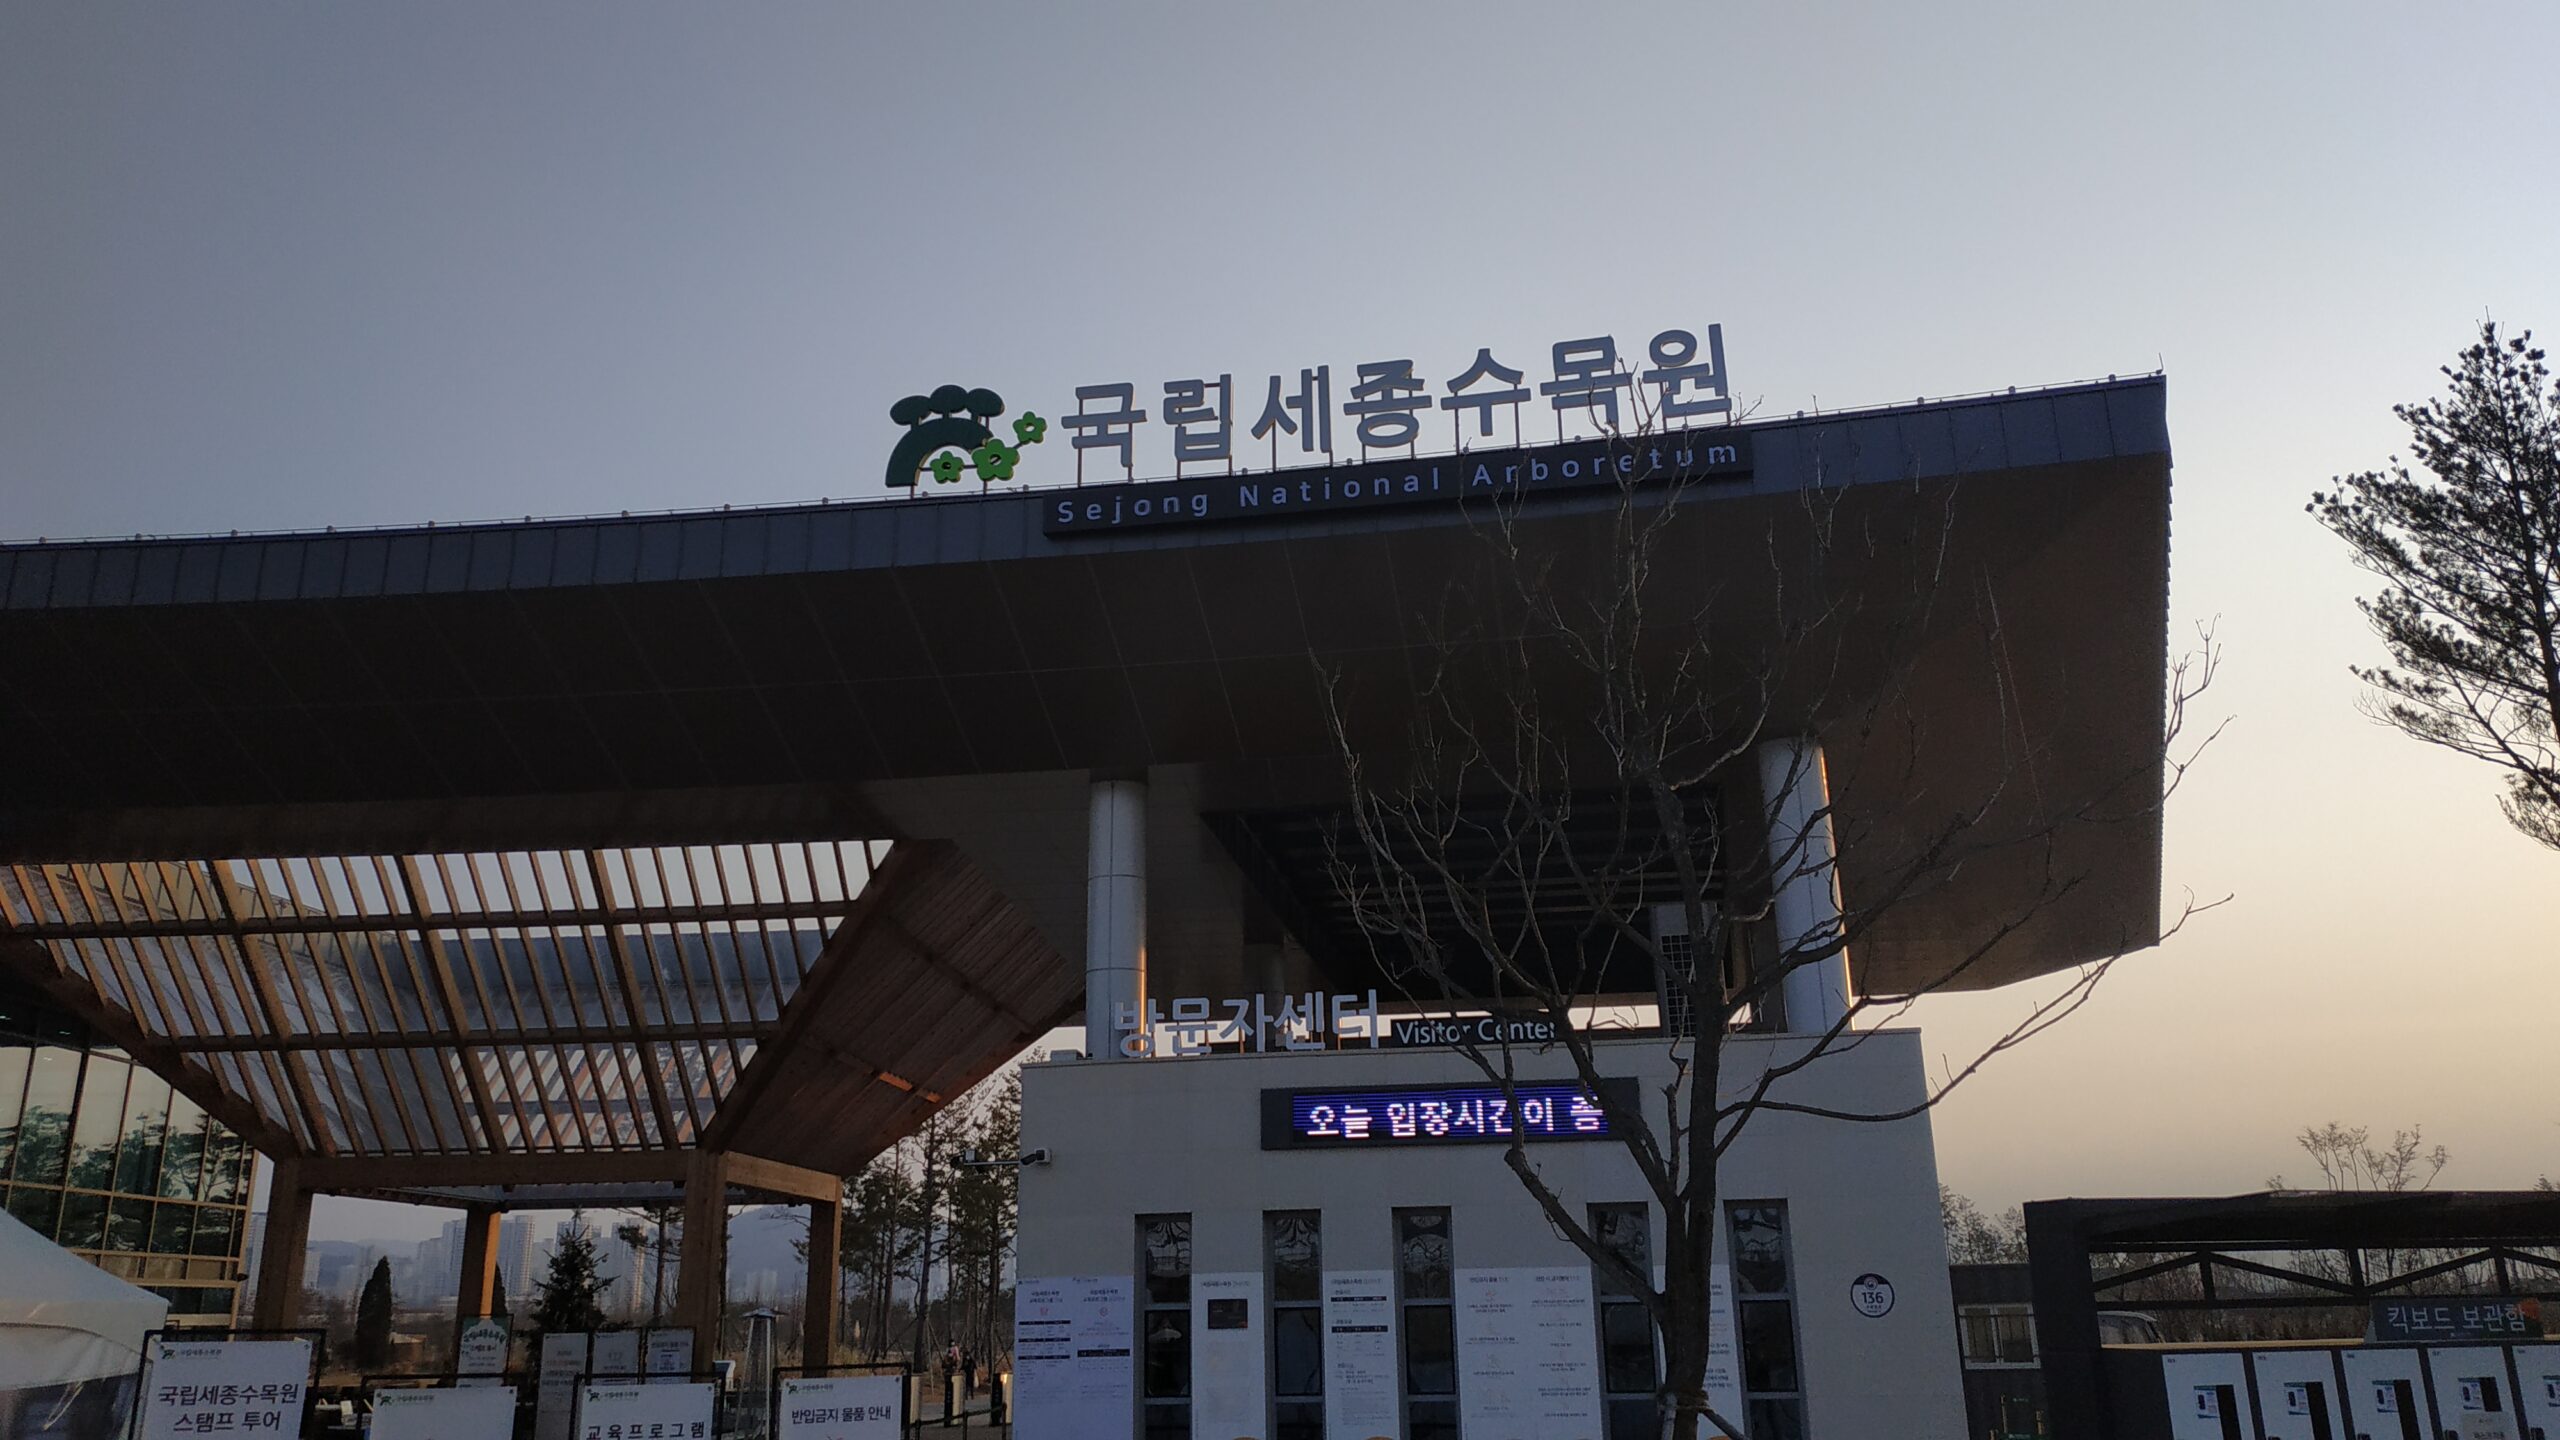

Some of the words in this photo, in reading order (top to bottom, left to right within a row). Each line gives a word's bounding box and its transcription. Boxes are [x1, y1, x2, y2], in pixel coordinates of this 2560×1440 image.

[1061, 324, 1732, 468] 국립세종수목원
[1057, 494, 1209, 525] Sejong
[1239, 466, 1440, 508] National
[1472, 444, 1738, 487] Arboretum
[1114, 989, 1379, 1058] 방문자센터
[1396, 1019, 1472, 1044] Visitor
[1306, 1104, 1373, 1138] 오늘
[1386, 1097, 1554, 1137] 입장시간이
[1861, 1292, 1884, 1304] 136
[2387, 1306, 2455, 1333] 킥보드
[2462, 1303, 2526, 1332] 보관함
[158, 1383, 299, 1407] 국립세종수목원
[173, 1411, 235, 1433] 스탬프
[242, 1410, 282, 1432] 투어
[792, 1408, 839, 1425] 반입금지
[842, 1406, 865, 1423] 물품
[868, 1405, 892, 1421] 안내
[586, 1421, 705, 1440] 교육프로그램
